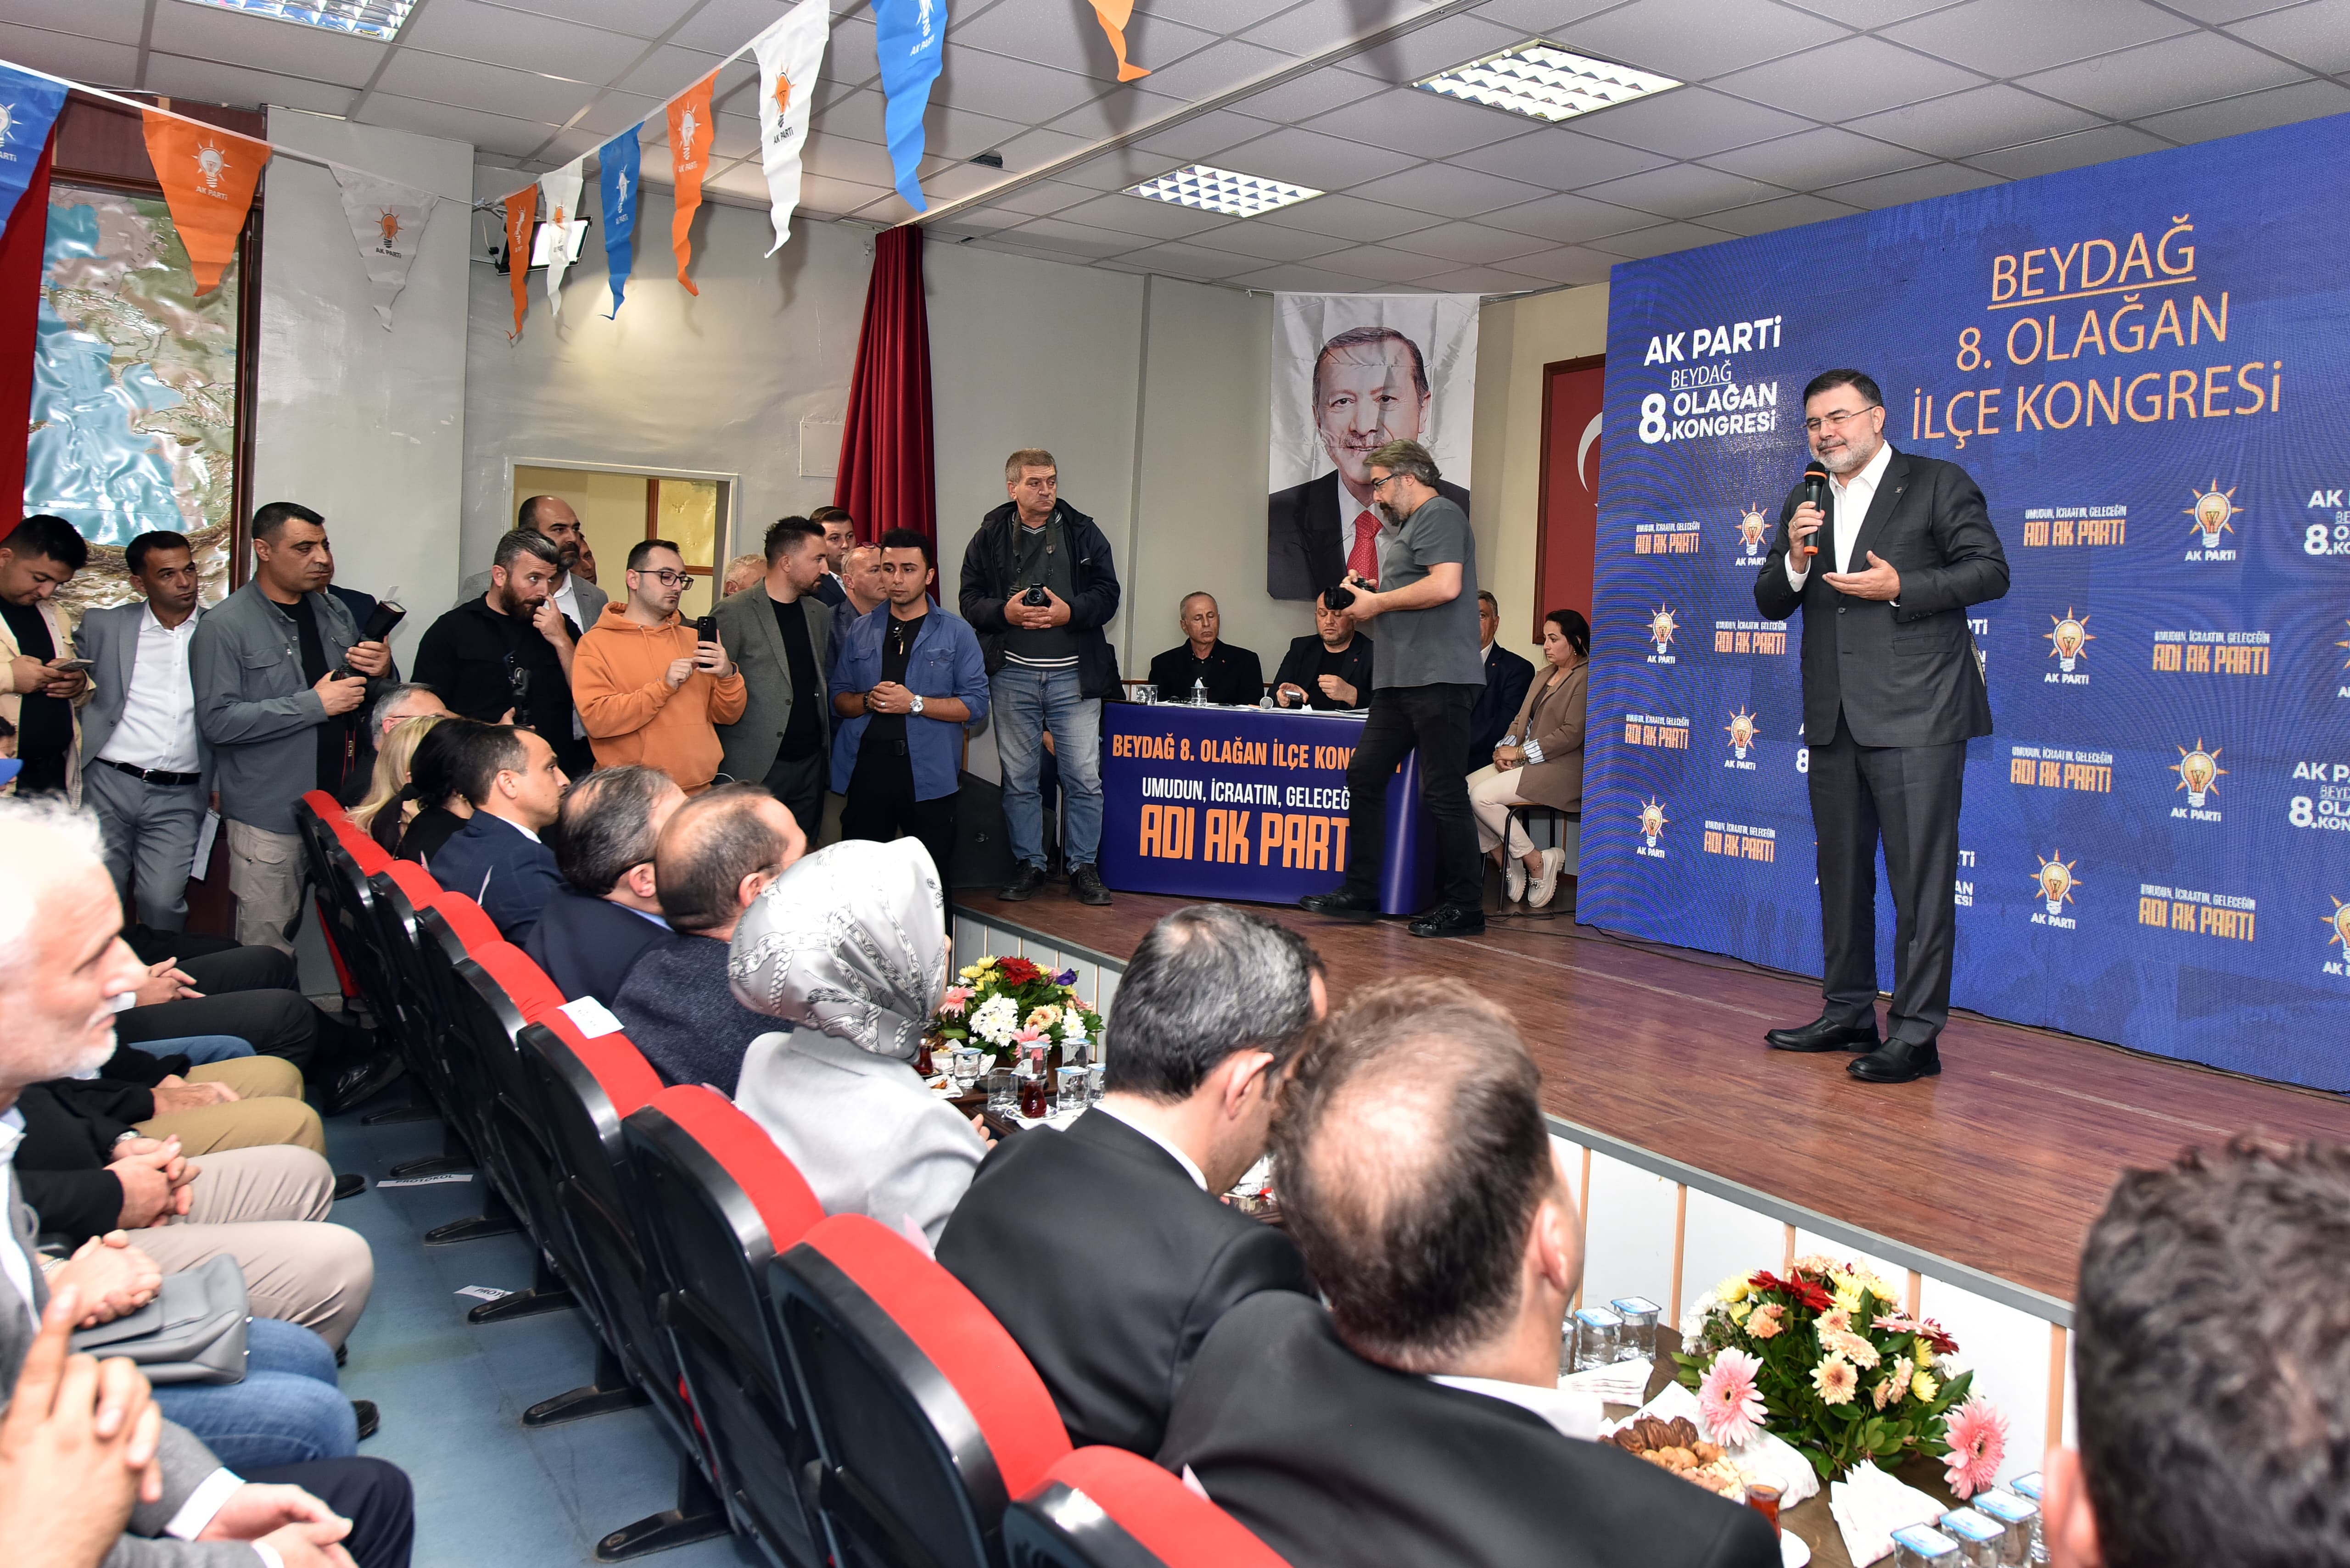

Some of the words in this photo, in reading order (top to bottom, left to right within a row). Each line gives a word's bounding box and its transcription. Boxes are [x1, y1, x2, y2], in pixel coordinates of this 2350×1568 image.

[1992, 213, 2195, 303] BEYDAĞ
[1956, 327, 1992, 372] 8.
[2006, 291, 2229, 366] OLAĞAN
[1644, 332, 1685, 366] AK
[1671, 359, 1732, 389] BEYDAĞ
[1639, 393, 1672, 444] 8.
[1673, 381, 1778, 416] OLAĞAN
[1912, 388, 2002, 450] İLÇE
[2307, 490, 2343, 508] AK
[1654, 534, 1667, 553] AK
[2053, 521, 2074, 546] AK
[2304, 524, 2333, 555] 8.
[1735, 557, 1746, 566] AK
[2185, 550, 2202, 561] AK
[1735, 632, 1750, 653] AK
[1647, 655, 1656, 664] AK
[2186, 645, 2210, 673] AK
[2044, 673, 2059, 683] AK
[1643, 725, 1656, 746] AK
[1113, 732, 1175, 760] BEYDAĞ
[1180, 738, 1195, 762] 8.
[1200, 736, 1267, 765] OLAĞAN
[1272, 738, 1309, 770] İLÇE
[1724, 760, 1735, 769] AK
[2039, 760, 2061, 787] AK
[2292, 762, 2328, 781] AK
[1142, 776, 1207, 804] UMUDUN,
[1211, 778, 1282, 809] İCRAATIN,
[1286, 785, 1351, 810] GELECEĞ
[2171, 807, 2188, 819] AK
[2288, 796, 2317, 829] 8.
[1139, 804, 1195, 860] ADI
[1204, 809, 1250, 865] AK
[1259, 812, 1350, 872] PART
[1724, 834, 1739, 856] AK
[1636, 846, 1646, 855] AK
[2031, 912, 2046, 925] AK
[2172, 902, 2196, 932] AK
[2322, 961, 2343, 975] AK
[395, 1174, 454, 1184] PROTOKOL
